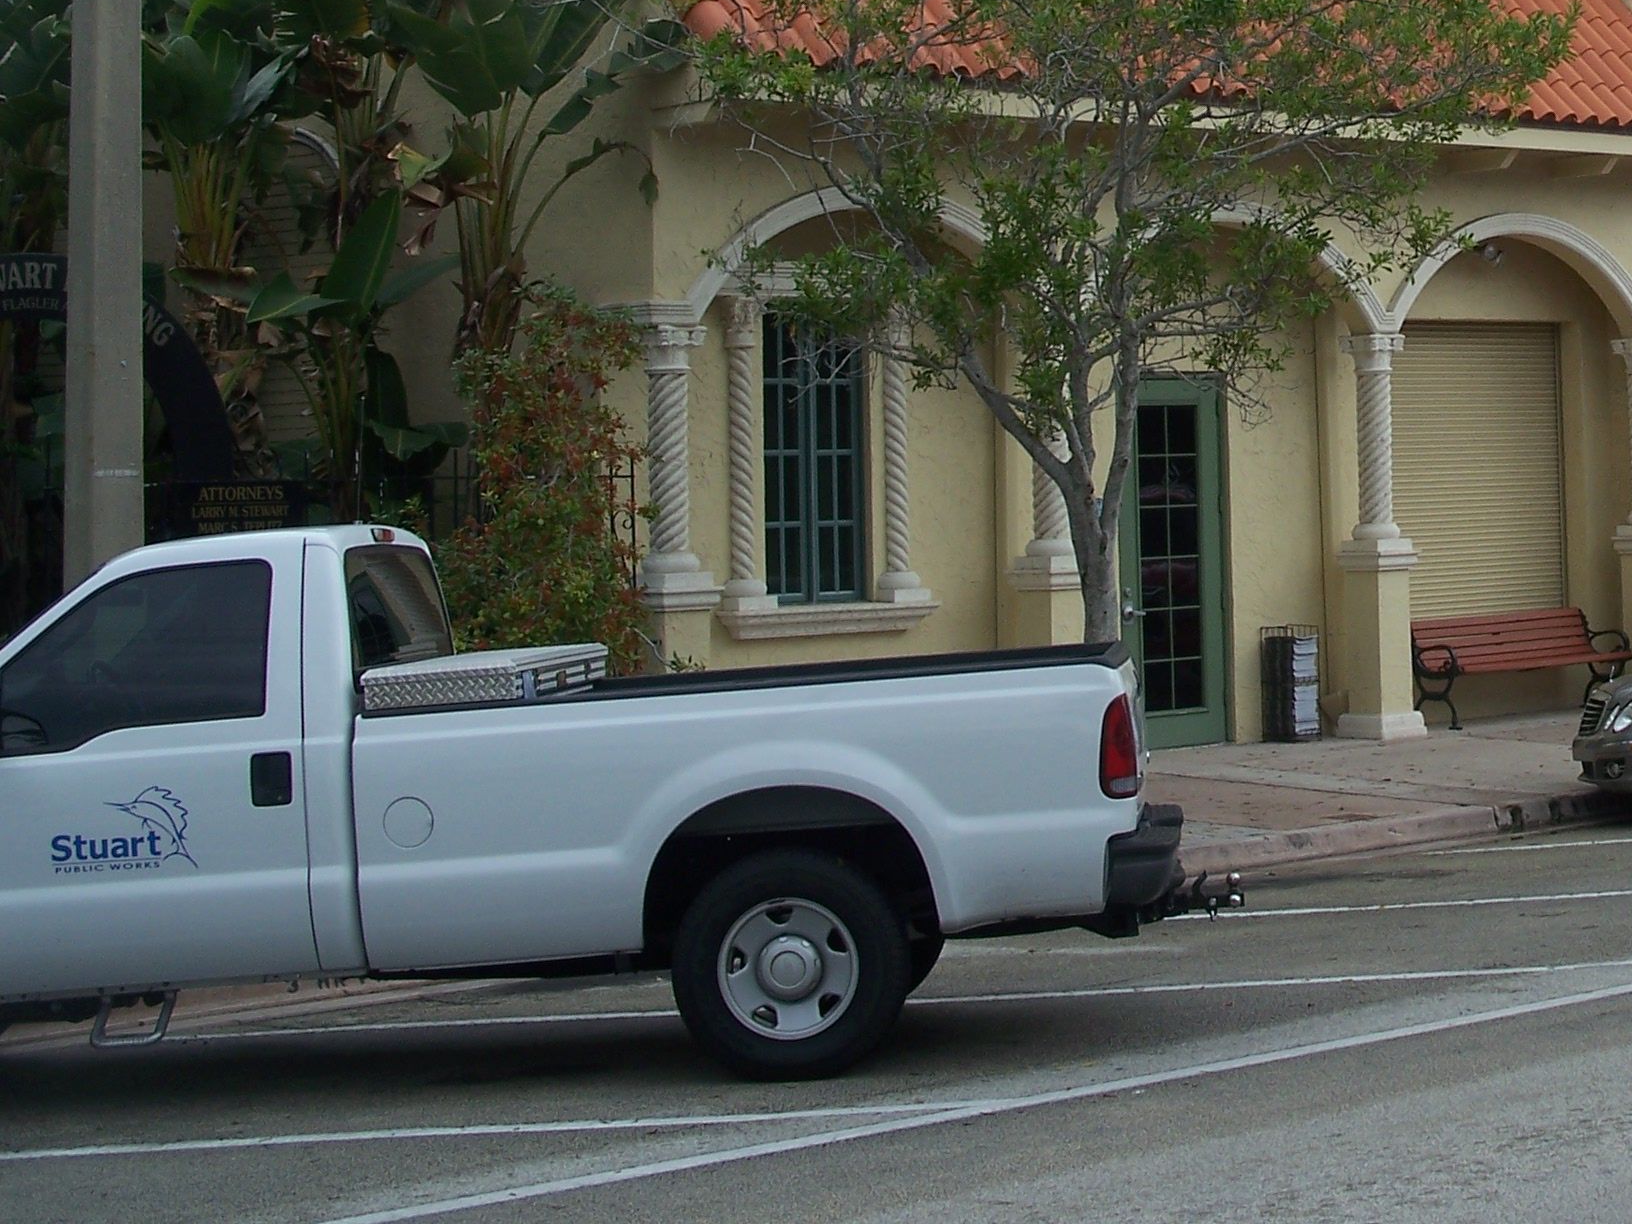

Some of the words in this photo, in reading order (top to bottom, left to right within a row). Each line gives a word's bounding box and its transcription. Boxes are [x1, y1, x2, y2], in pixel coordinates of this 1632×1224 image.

[2, 295, 60, 311] FLAGLER
[198, 486, 285, 501] ATTORNEYS
[192, 505, 226, 518] LARRY
[241, 505, 289, 517] STEWART
[51, 830, 161, 862] Stuart
[55, 863, 104, 874] PUBLIC
[110, 861, 160, 871] WORKS
